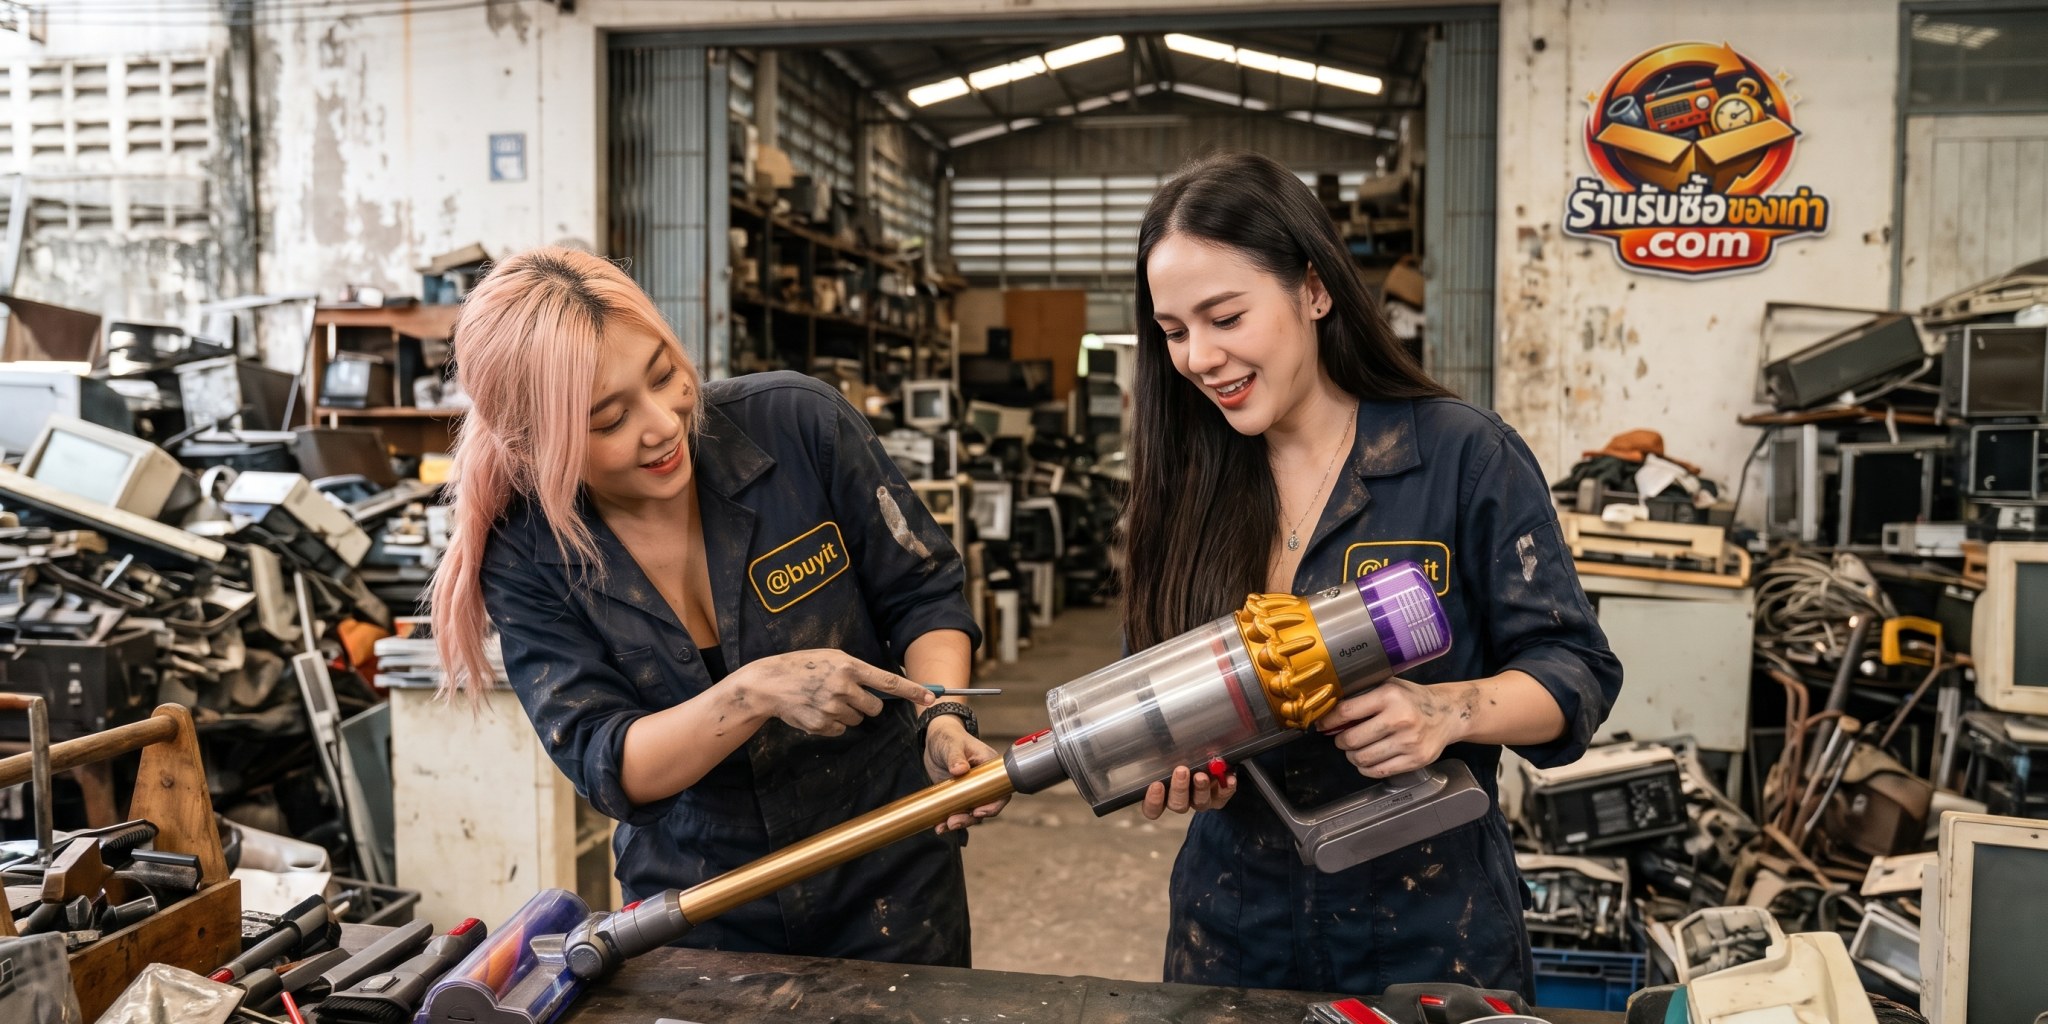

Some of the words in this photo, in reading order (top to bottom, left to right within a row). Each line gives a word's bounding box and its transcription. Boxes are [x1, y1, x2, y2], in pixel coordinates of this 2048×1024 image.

[1569, 174, 1825, 228] ร้านรับซื้อของเก่า
[1635, 231, 1751, 258] .com
[766, 542, 838, 595] @buyit
[1339, 641, 1368, 658] dyson
